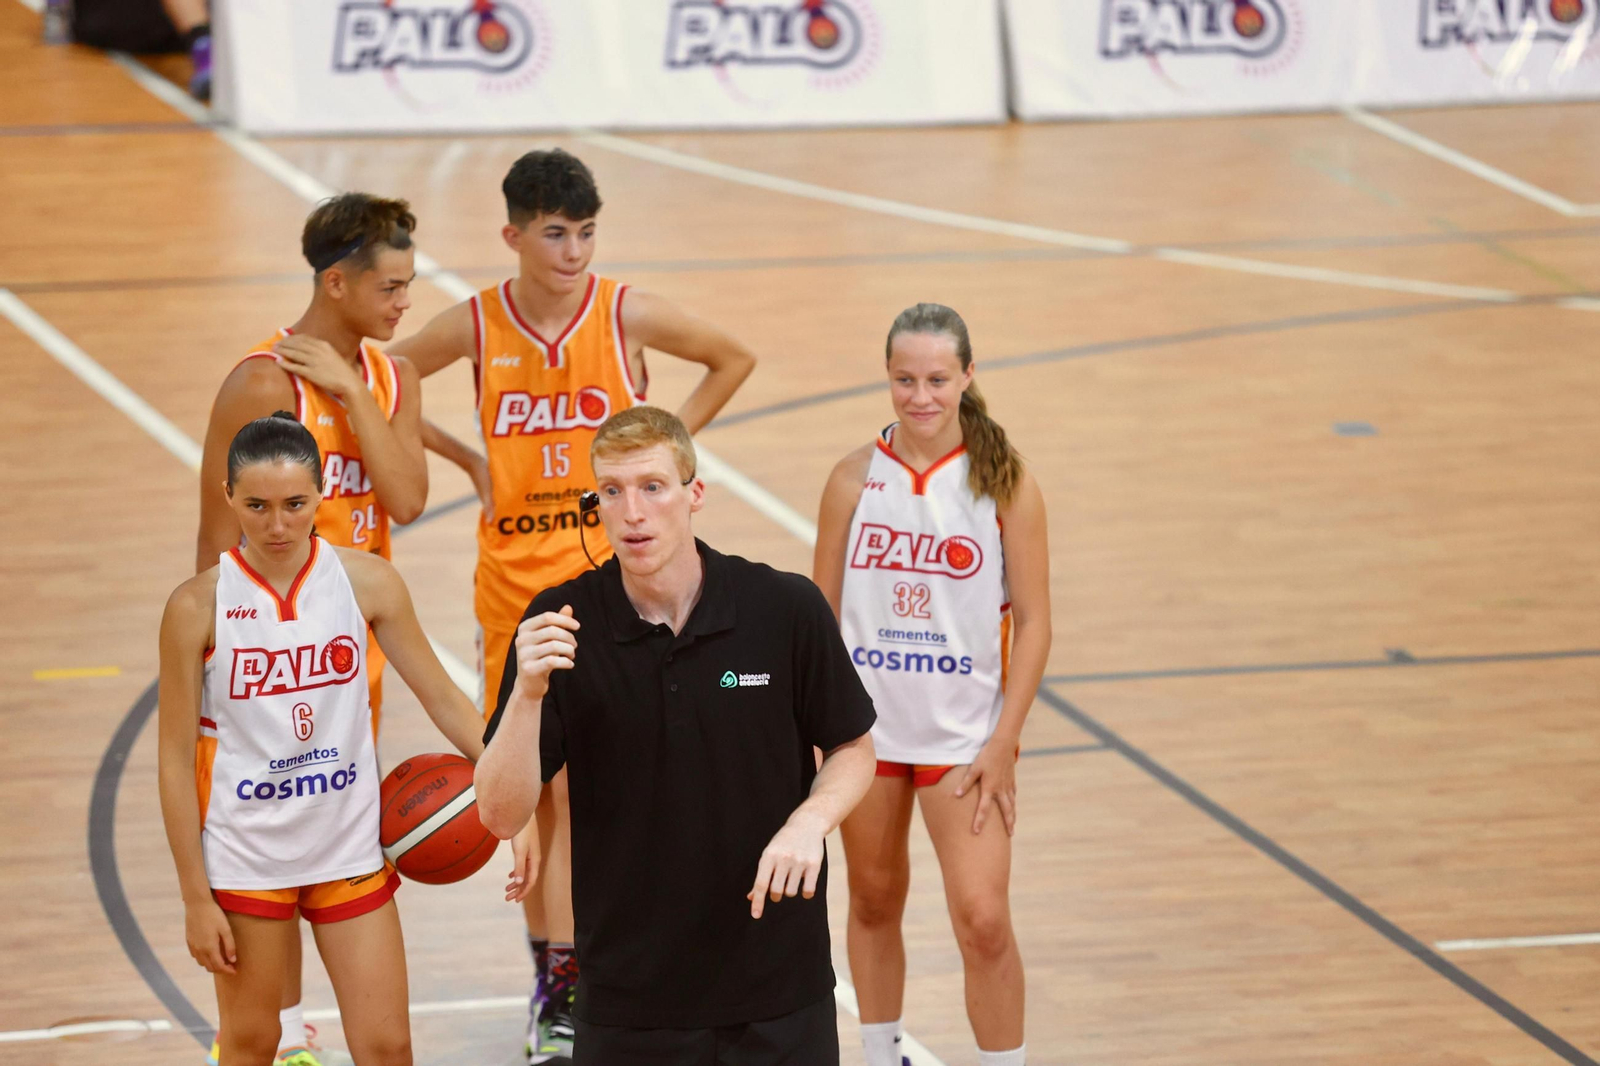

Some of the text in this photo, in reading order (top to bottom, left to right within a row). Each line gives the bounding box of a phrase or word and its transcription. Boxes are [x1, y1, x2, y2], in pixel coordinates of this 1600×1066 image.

[332, 0, 533, 74] PALO
[665, 0, 862, 70] PALO
[1098, 0, 1286, 59] PALO
[491, 385, 611, 437] PALO
[322, 451, 373, 500] PA
[541, 442, 571, 478] 15
[862, 476, 887, 492] ive
[498, 509, 601, 535] cosmo
[850, 523, 983, 580] EL PALO
[226, 605, 257, 620] vive
[893, 581, 931, 619] 32
[878, 627, 947, 643] cementos
[229, 635, 360, 699] EL PALO
[852, 646, 972, 675] cosmos
[292, 702, 313, 741] 6
[269, 746, 339, 770] cementos
[236, 763, 356, 801] cosmos
[398, 776, 449, 817] molten
